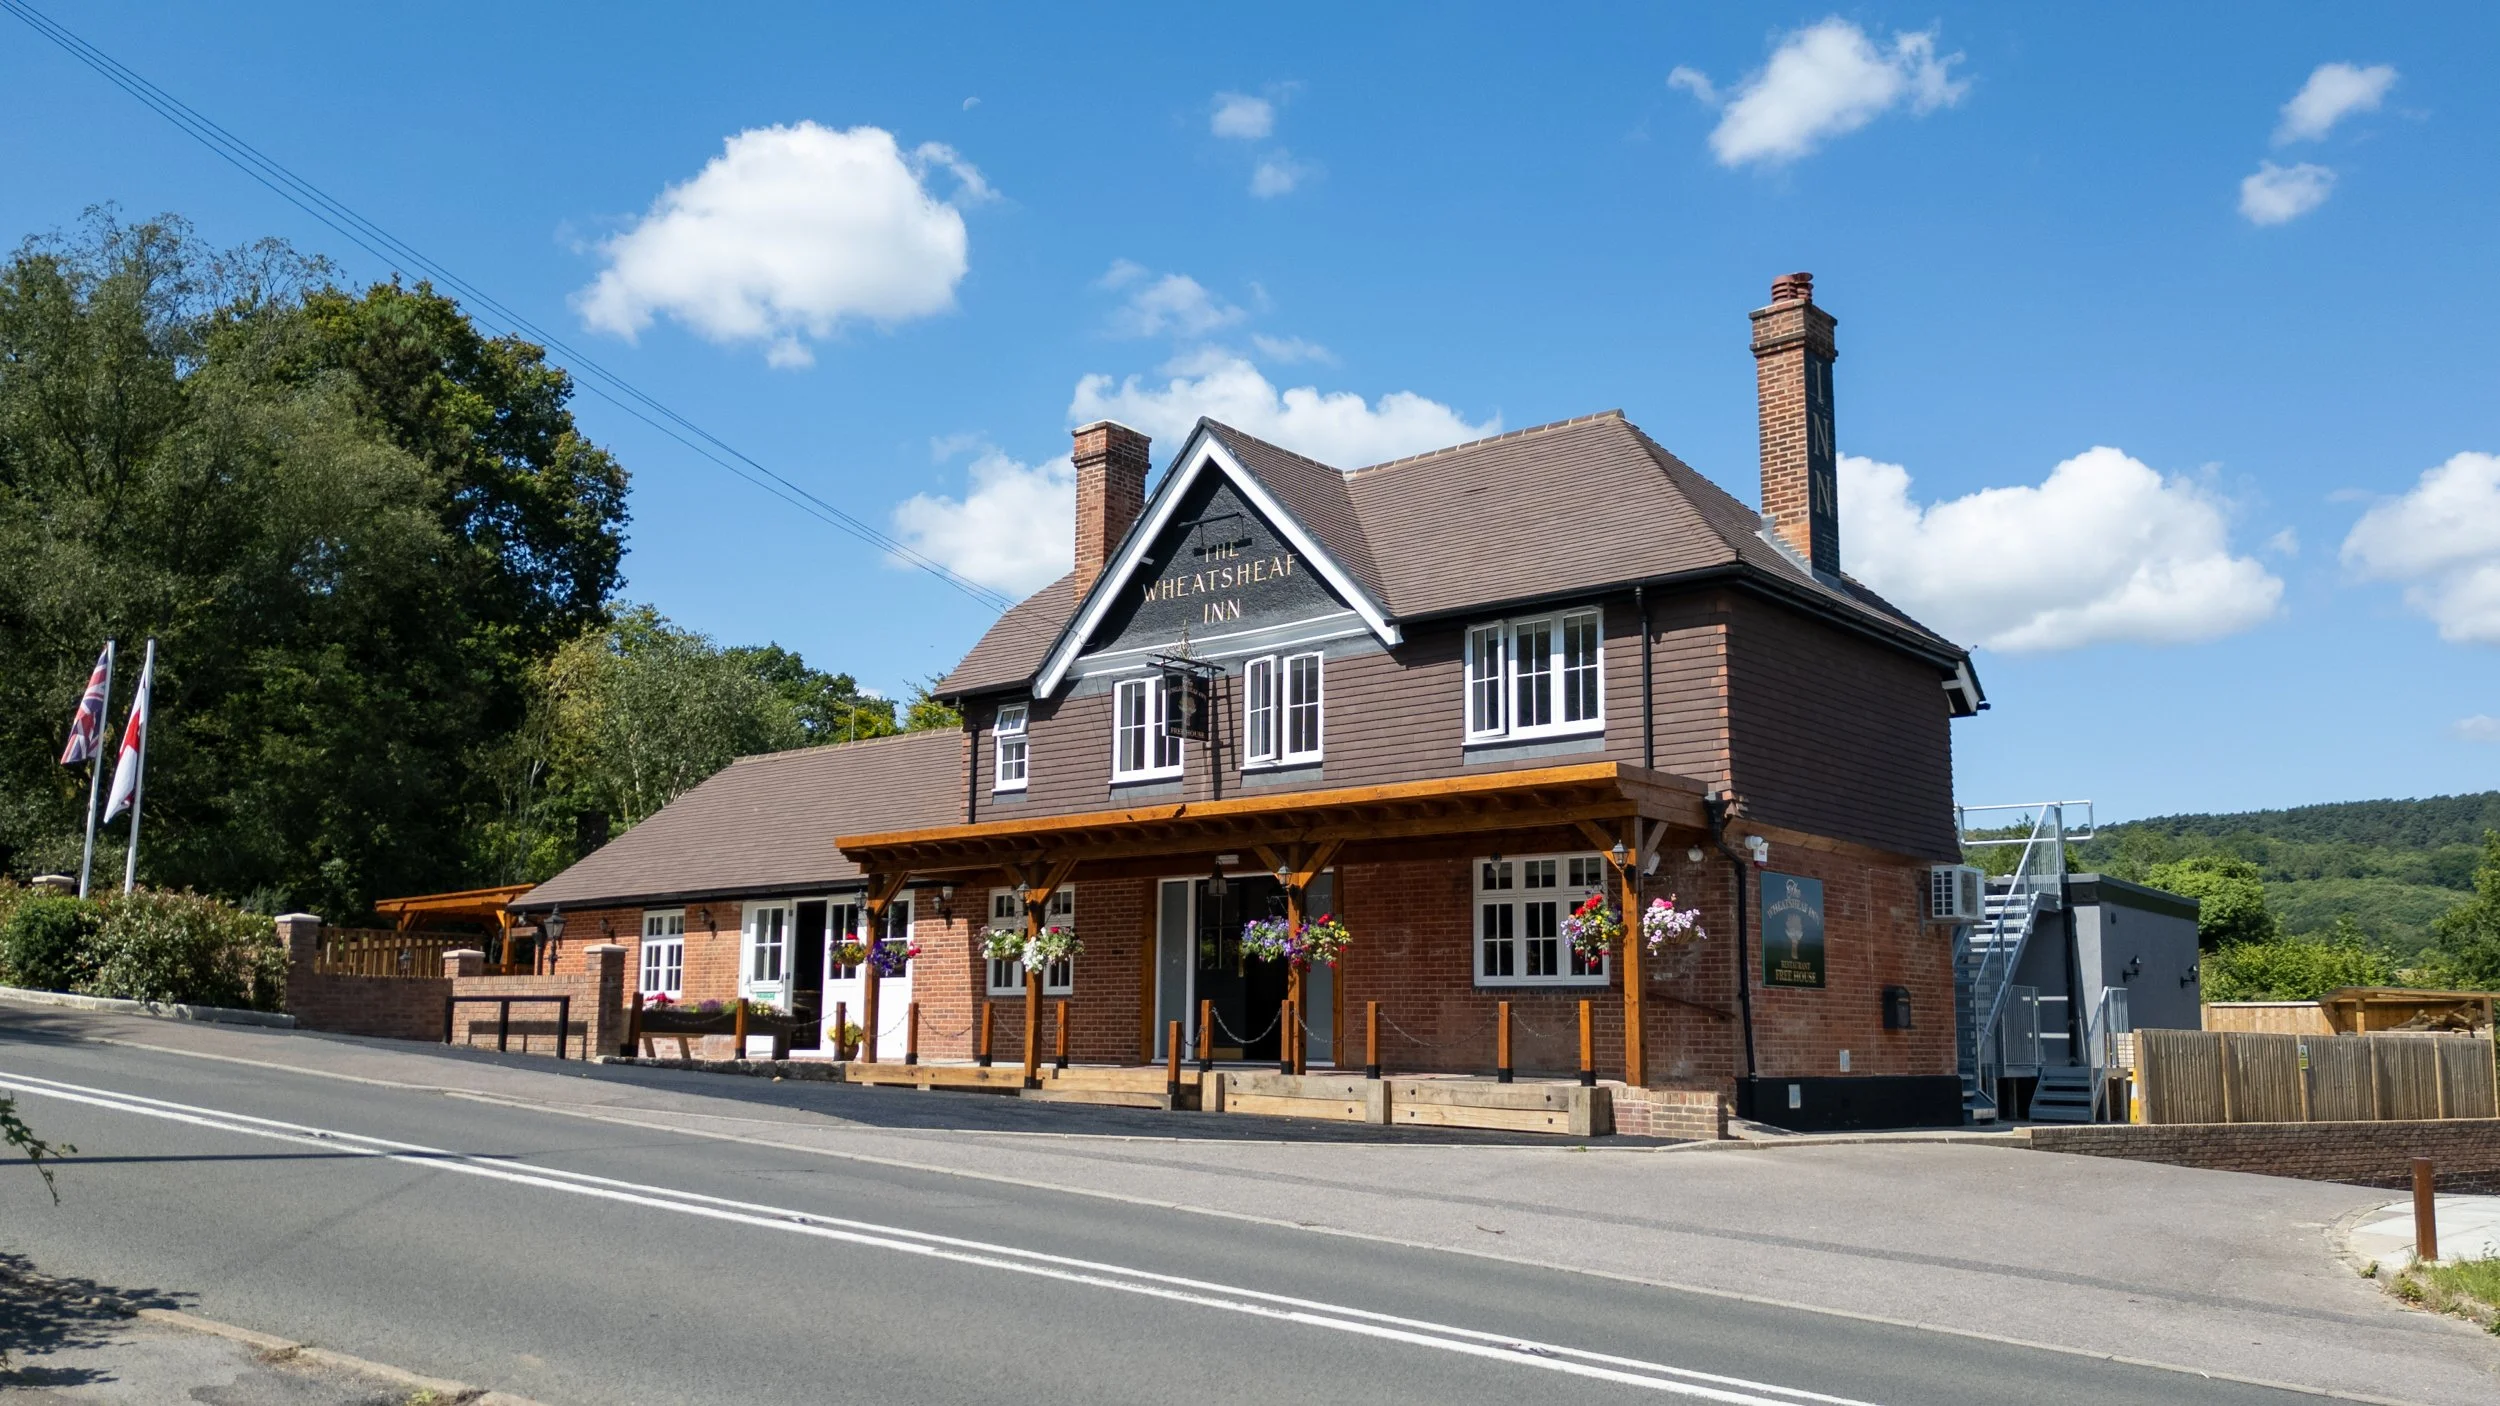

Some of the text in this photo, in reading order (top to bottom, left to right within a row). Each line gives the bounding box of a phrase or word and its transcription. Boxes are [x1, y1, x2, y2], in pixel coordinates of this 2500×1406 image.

[1812, 360, 1832, 518] INN
[1205, 541, 1239, 563] THE
[1143, 553, 1298, 601] WHEATSHEAF
[1203, 598, 1240, 624] INN
[1776, 969, 1816, 983] FREE HOUSE
